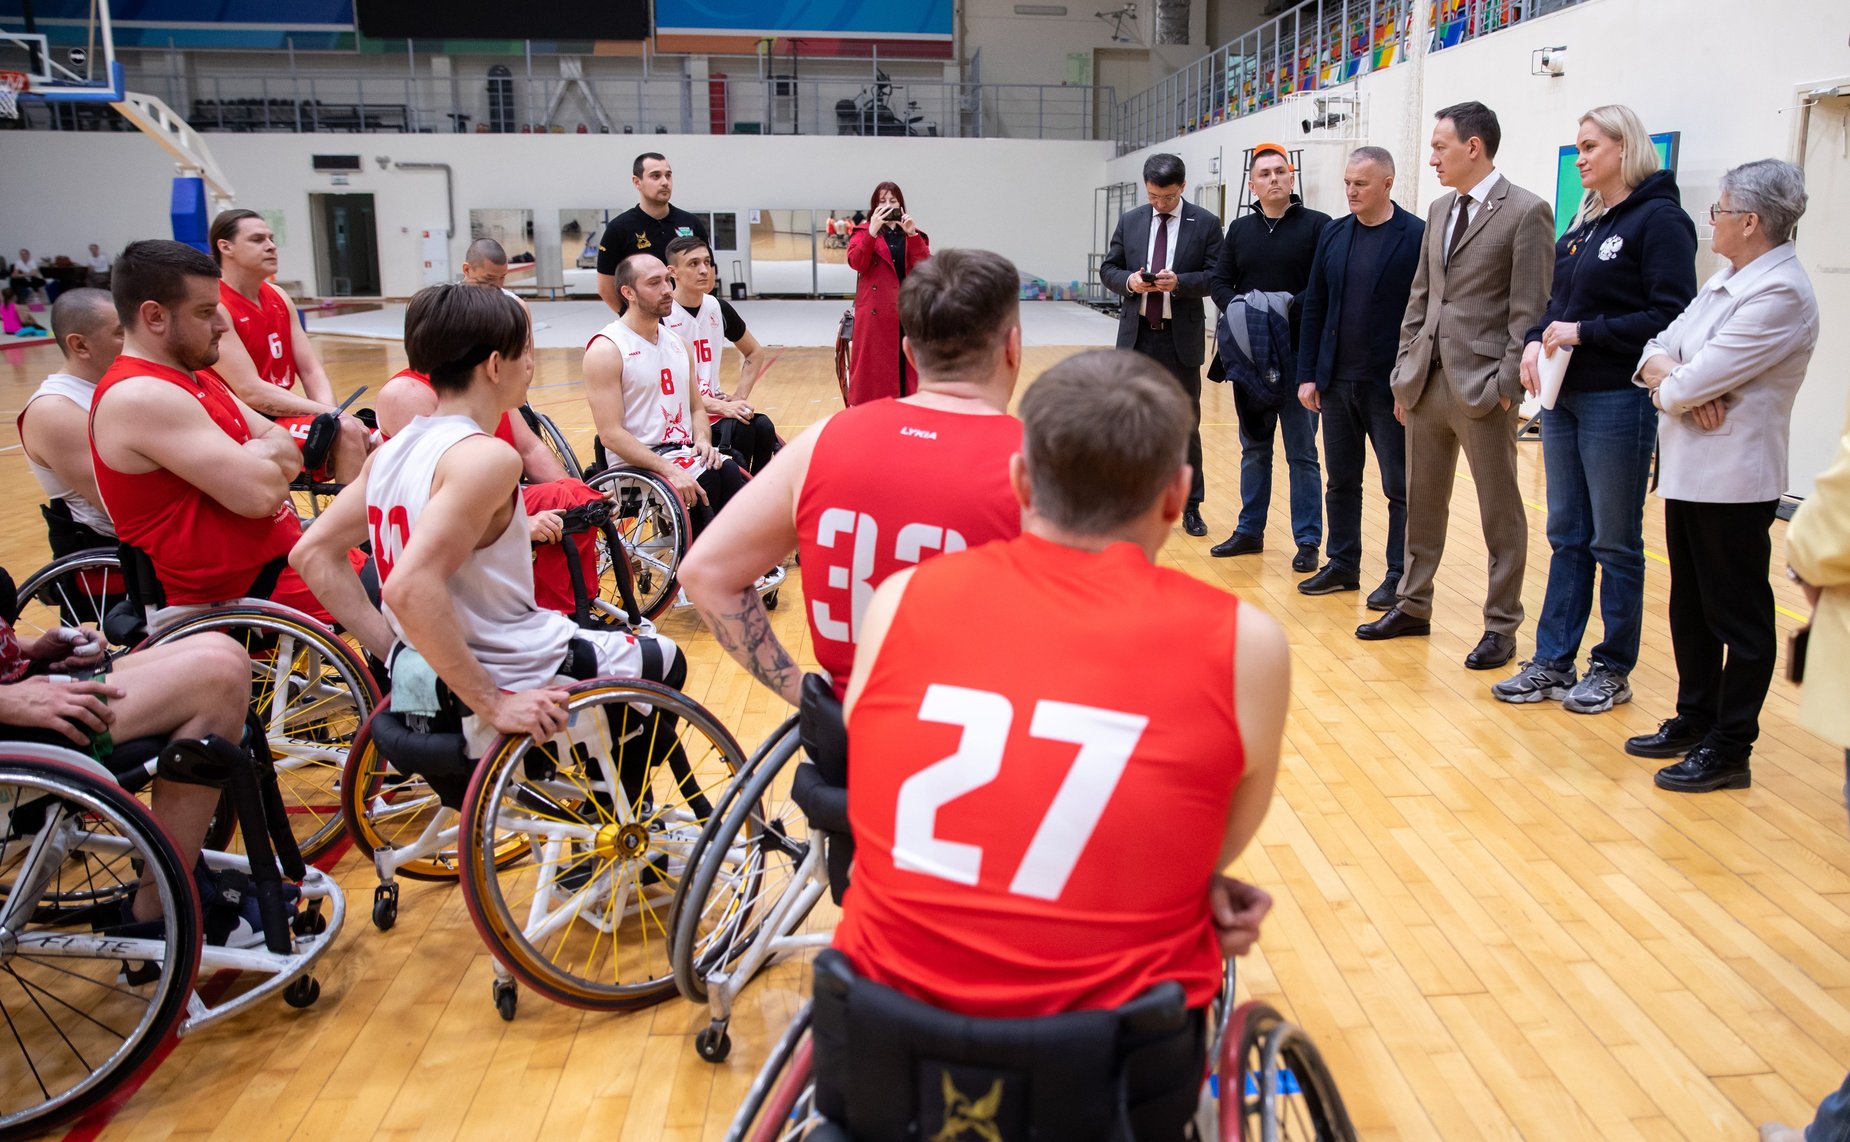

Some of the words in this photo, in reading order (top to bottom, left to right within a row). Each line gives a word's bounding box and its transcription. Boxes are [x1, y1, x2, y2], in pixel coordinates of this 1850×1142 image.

[268, 332, 283, 359] 6
[694, 338, 712, 364] 16
[660, 368, 675, 395] 8
[892, 684, 1150, 901] 27
